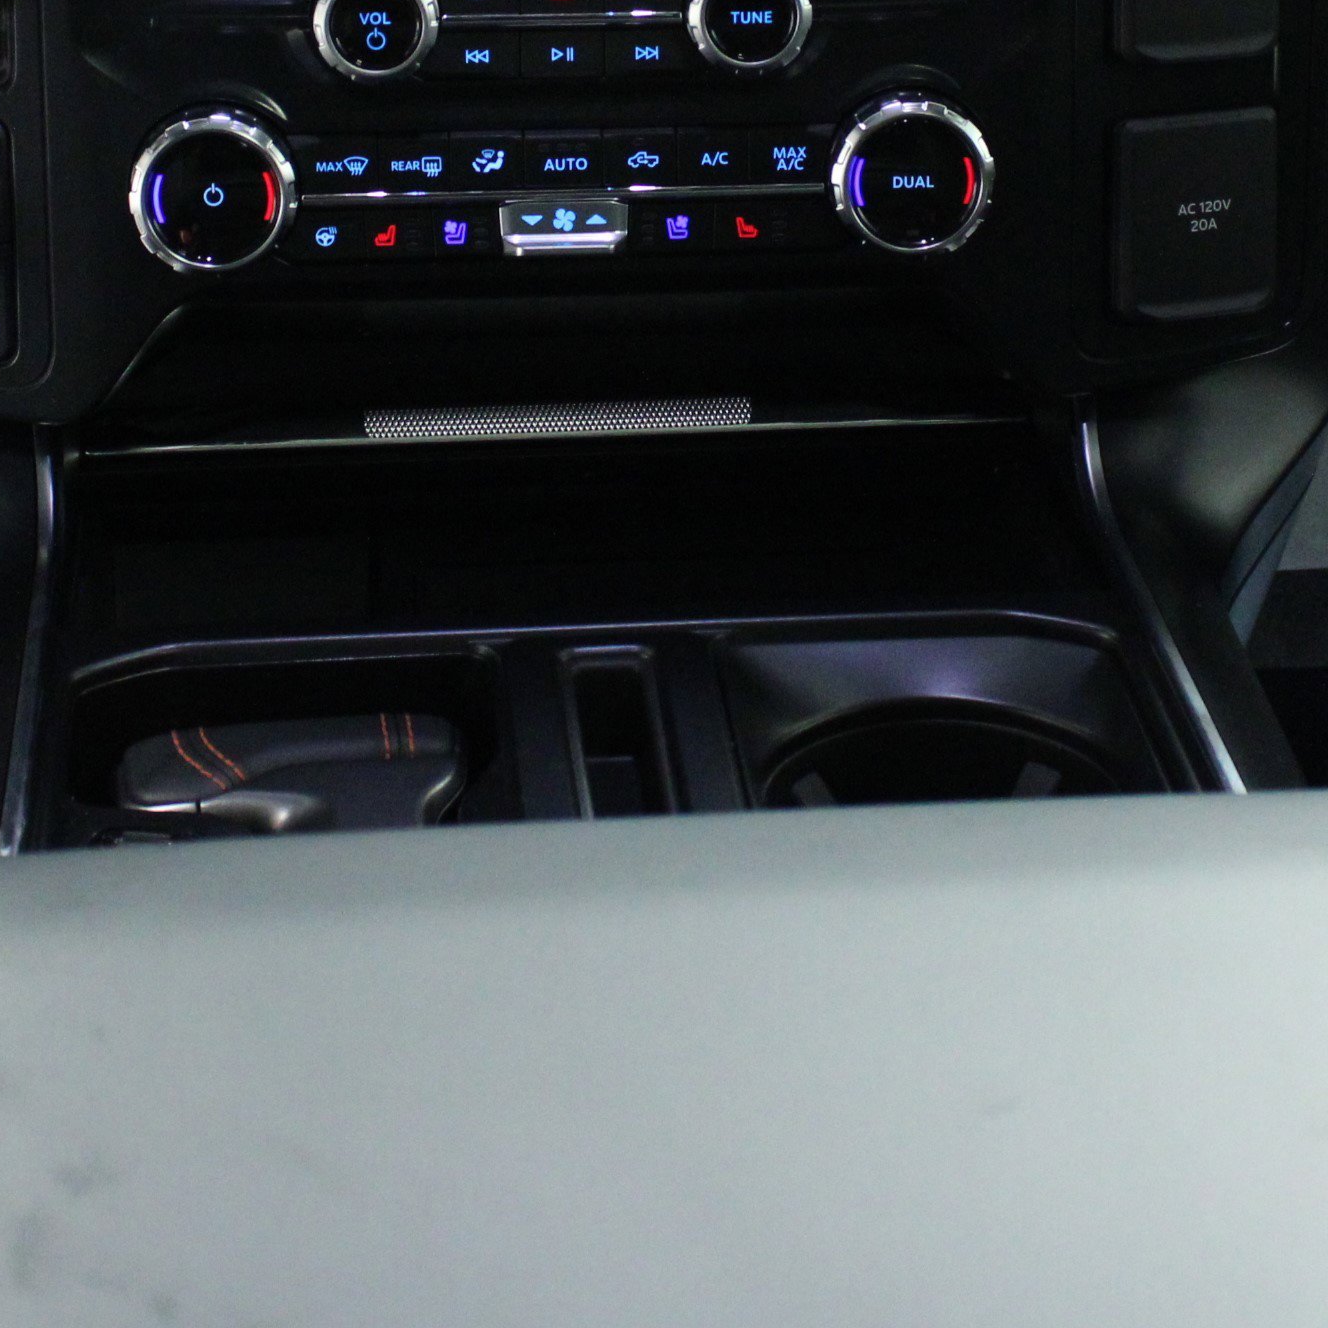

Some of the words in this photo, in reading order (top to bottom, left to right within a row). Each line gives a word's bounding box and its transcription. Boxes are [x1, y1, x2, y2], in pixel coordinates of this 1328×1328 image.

[359, 12, 391, 26] VOL
[731, 10, 772, 25] TUNE
[701, 152, 729, 167] A/C
[773, 146, 807, 160] MAX
[315, 160, 343, 173] MAX
[390, 159, 420, 172] REAR
[544, 158, 588, 171] AUTO
[776, 157, 805, 172] A/C
[892, 175, 934, 189] DUAL
[1177, 202, 1197, 216] AC
[1199, 198, 1232, 214] 120V
[1190, 218, 1218, 233] 20A
